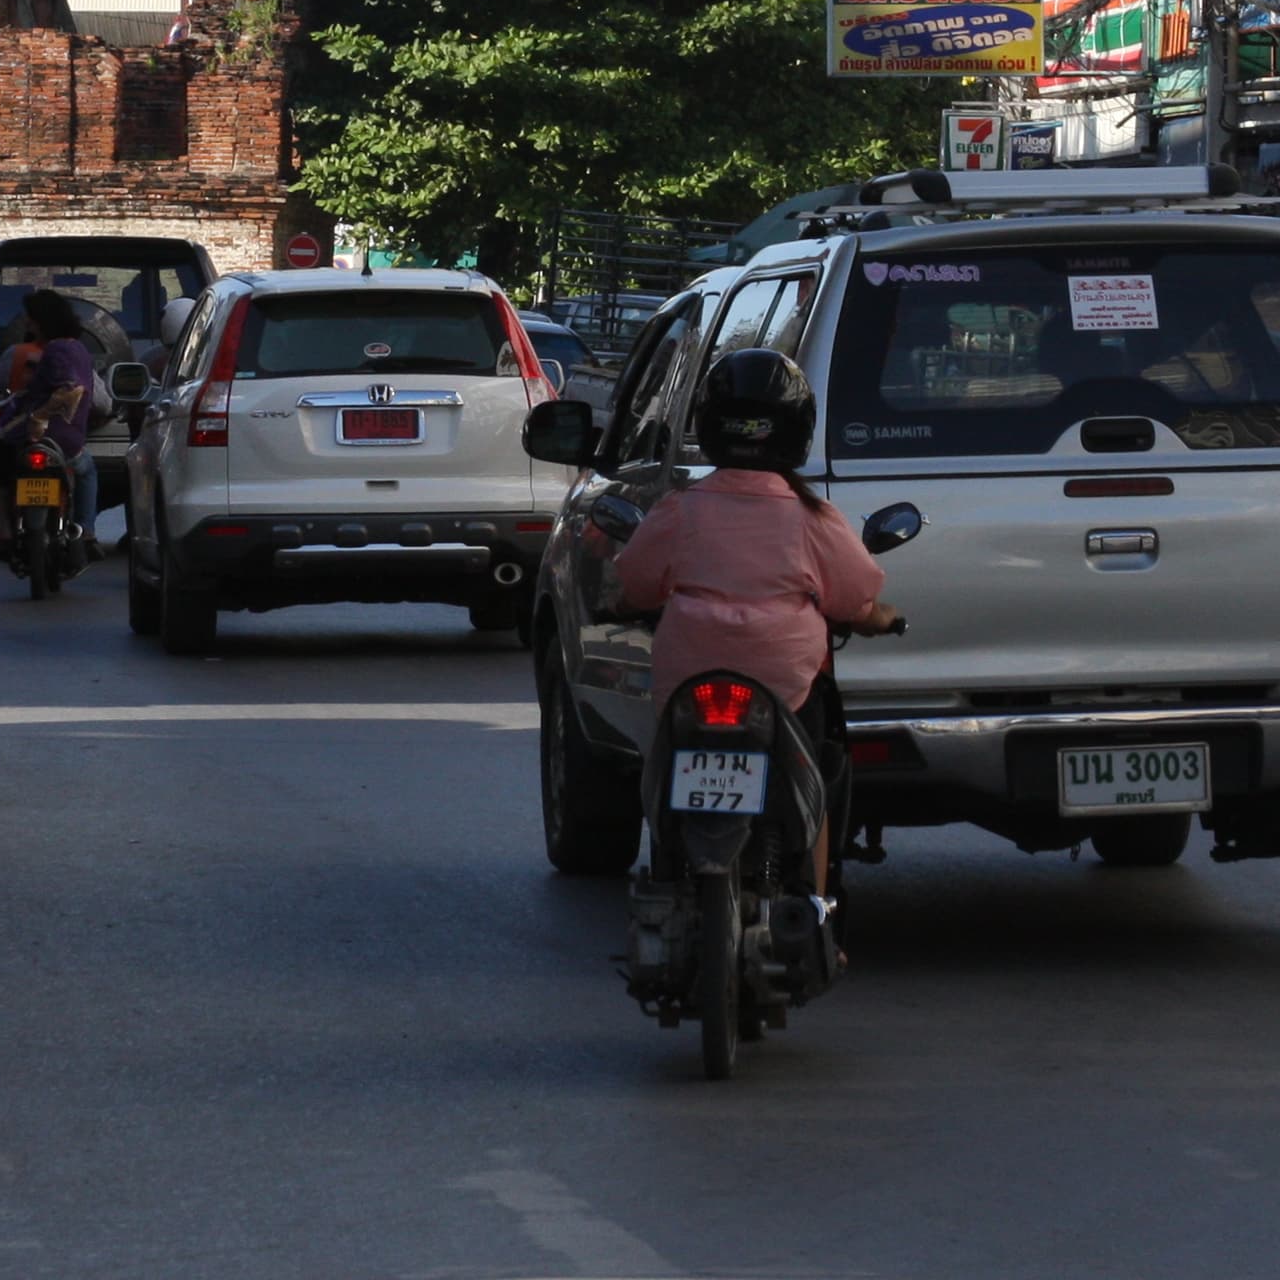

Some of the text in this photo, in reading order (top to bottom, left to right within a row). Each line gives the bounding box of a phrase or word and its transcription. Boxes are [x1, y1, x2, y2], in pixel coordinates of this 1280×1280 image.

[970, 13, 1009, 26] จาก
[958, 118, 993, 170] 7
[1125, 751, 1199, 783] 3003
[688, 791, 743, 810] 677
